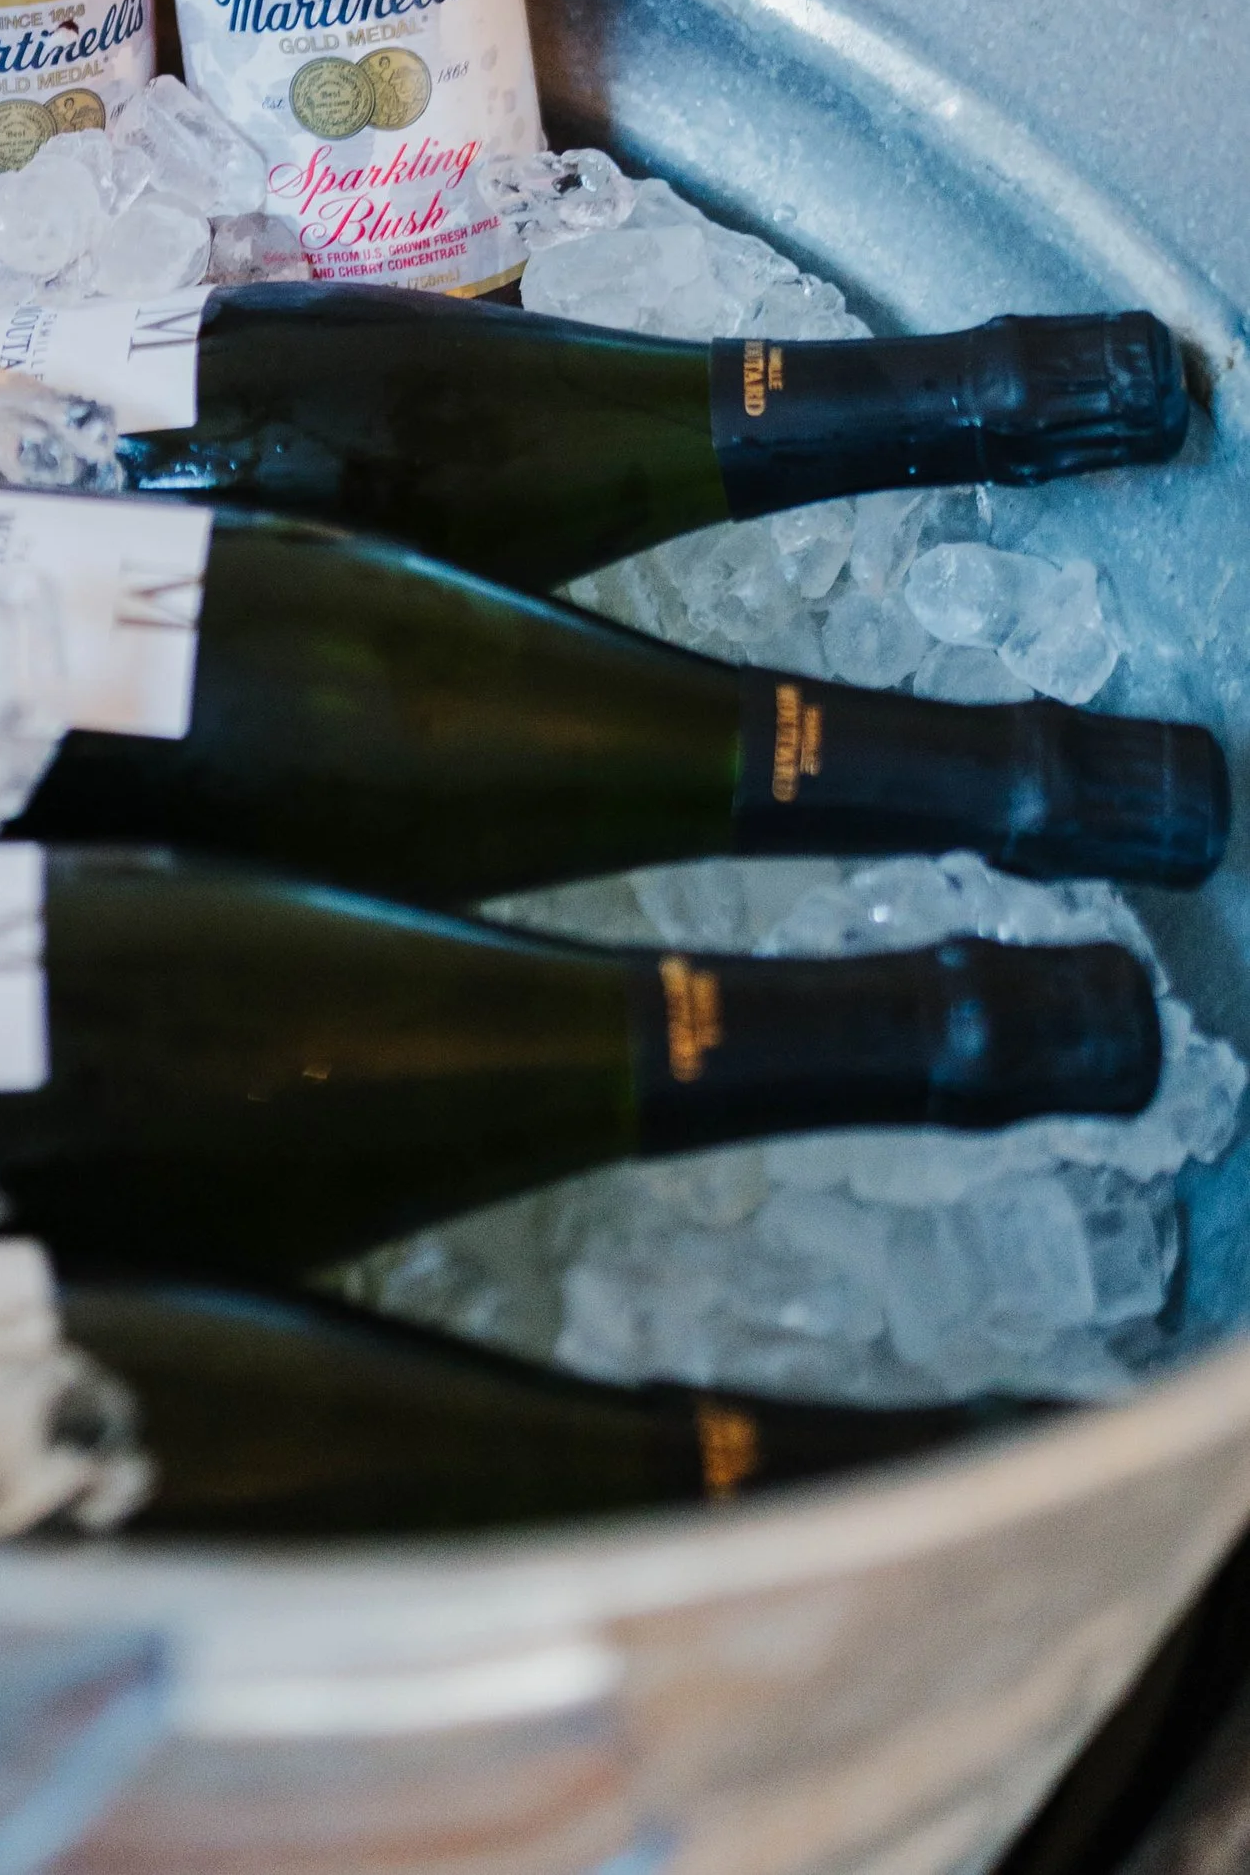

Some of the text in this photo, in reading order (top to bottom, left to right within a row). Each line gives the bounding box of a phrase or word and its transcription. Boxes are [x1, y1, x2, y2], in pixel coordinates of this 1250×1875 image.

[278, 33, 340, 56] GOLD
[266, 136, 484, 216] Sparkling
[299, 189, 451, 250] Blush
[327, 250, 360, 265] FROM
[388, 239, 431, 257] GROWN
[433, 227, 468, 247] FRESH
[470, 215, 502, 237] APPLE
[312, 243, 468, 280] AND CHERRY CONCENTRATE
[0, 304, 43, 370] MOUTA
